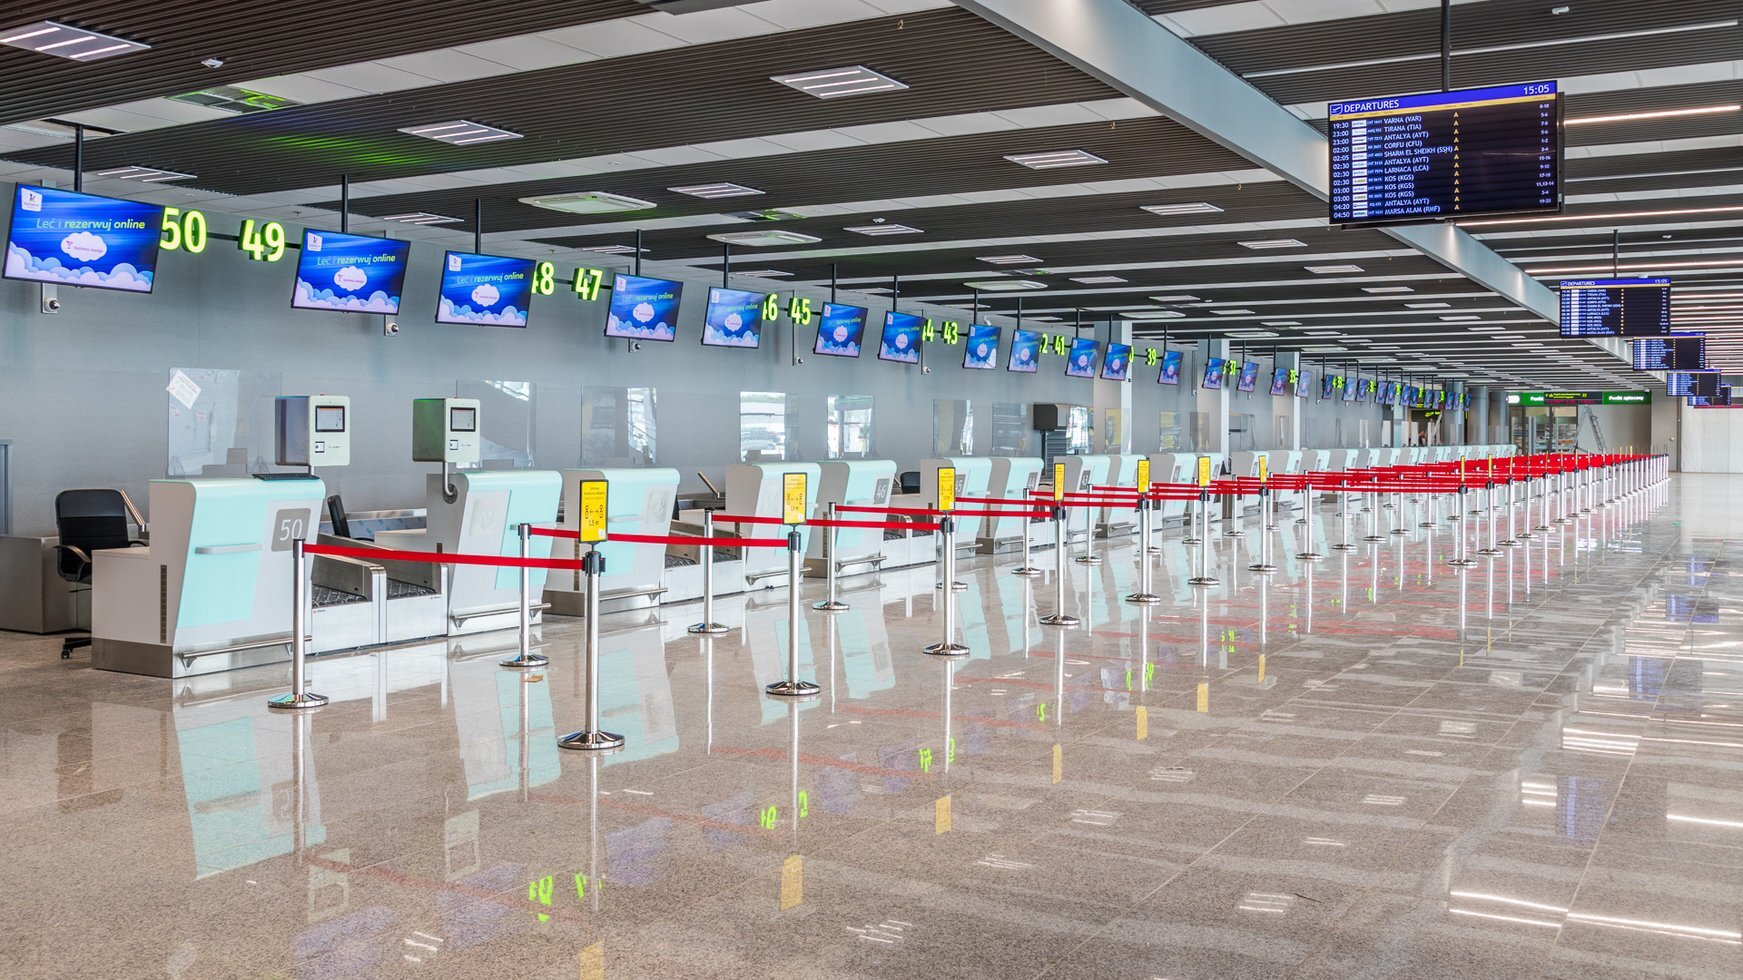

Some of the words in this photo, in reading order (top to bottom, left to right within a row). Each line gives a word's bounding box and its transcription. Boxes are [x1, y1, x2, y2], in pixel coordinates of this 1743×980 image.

[1344, 100, 1399, 113] DEPARTURES
[1524, 84, 1549, 94] 15:05
[36, 218, 55, 229] Leć
[58, 220, 62, 228] i
[64, 220, 111, 231] rezerwuj
[114, 219, 145, 229] online
[160, 206, 207, 254] 50
[241, 220, 285, 262] 49
[337, 255, 371, 265] rezerwuj
[373, 254, 395, 263] online
[504, 272, 523, 281] online
[575, 268, 602, 301] 47
[791, 297, 811, 325] 45
[943, 321, 958, 345] 43
[877, 484, 886, 498] 46
[280, 519, 303, 541] 50
